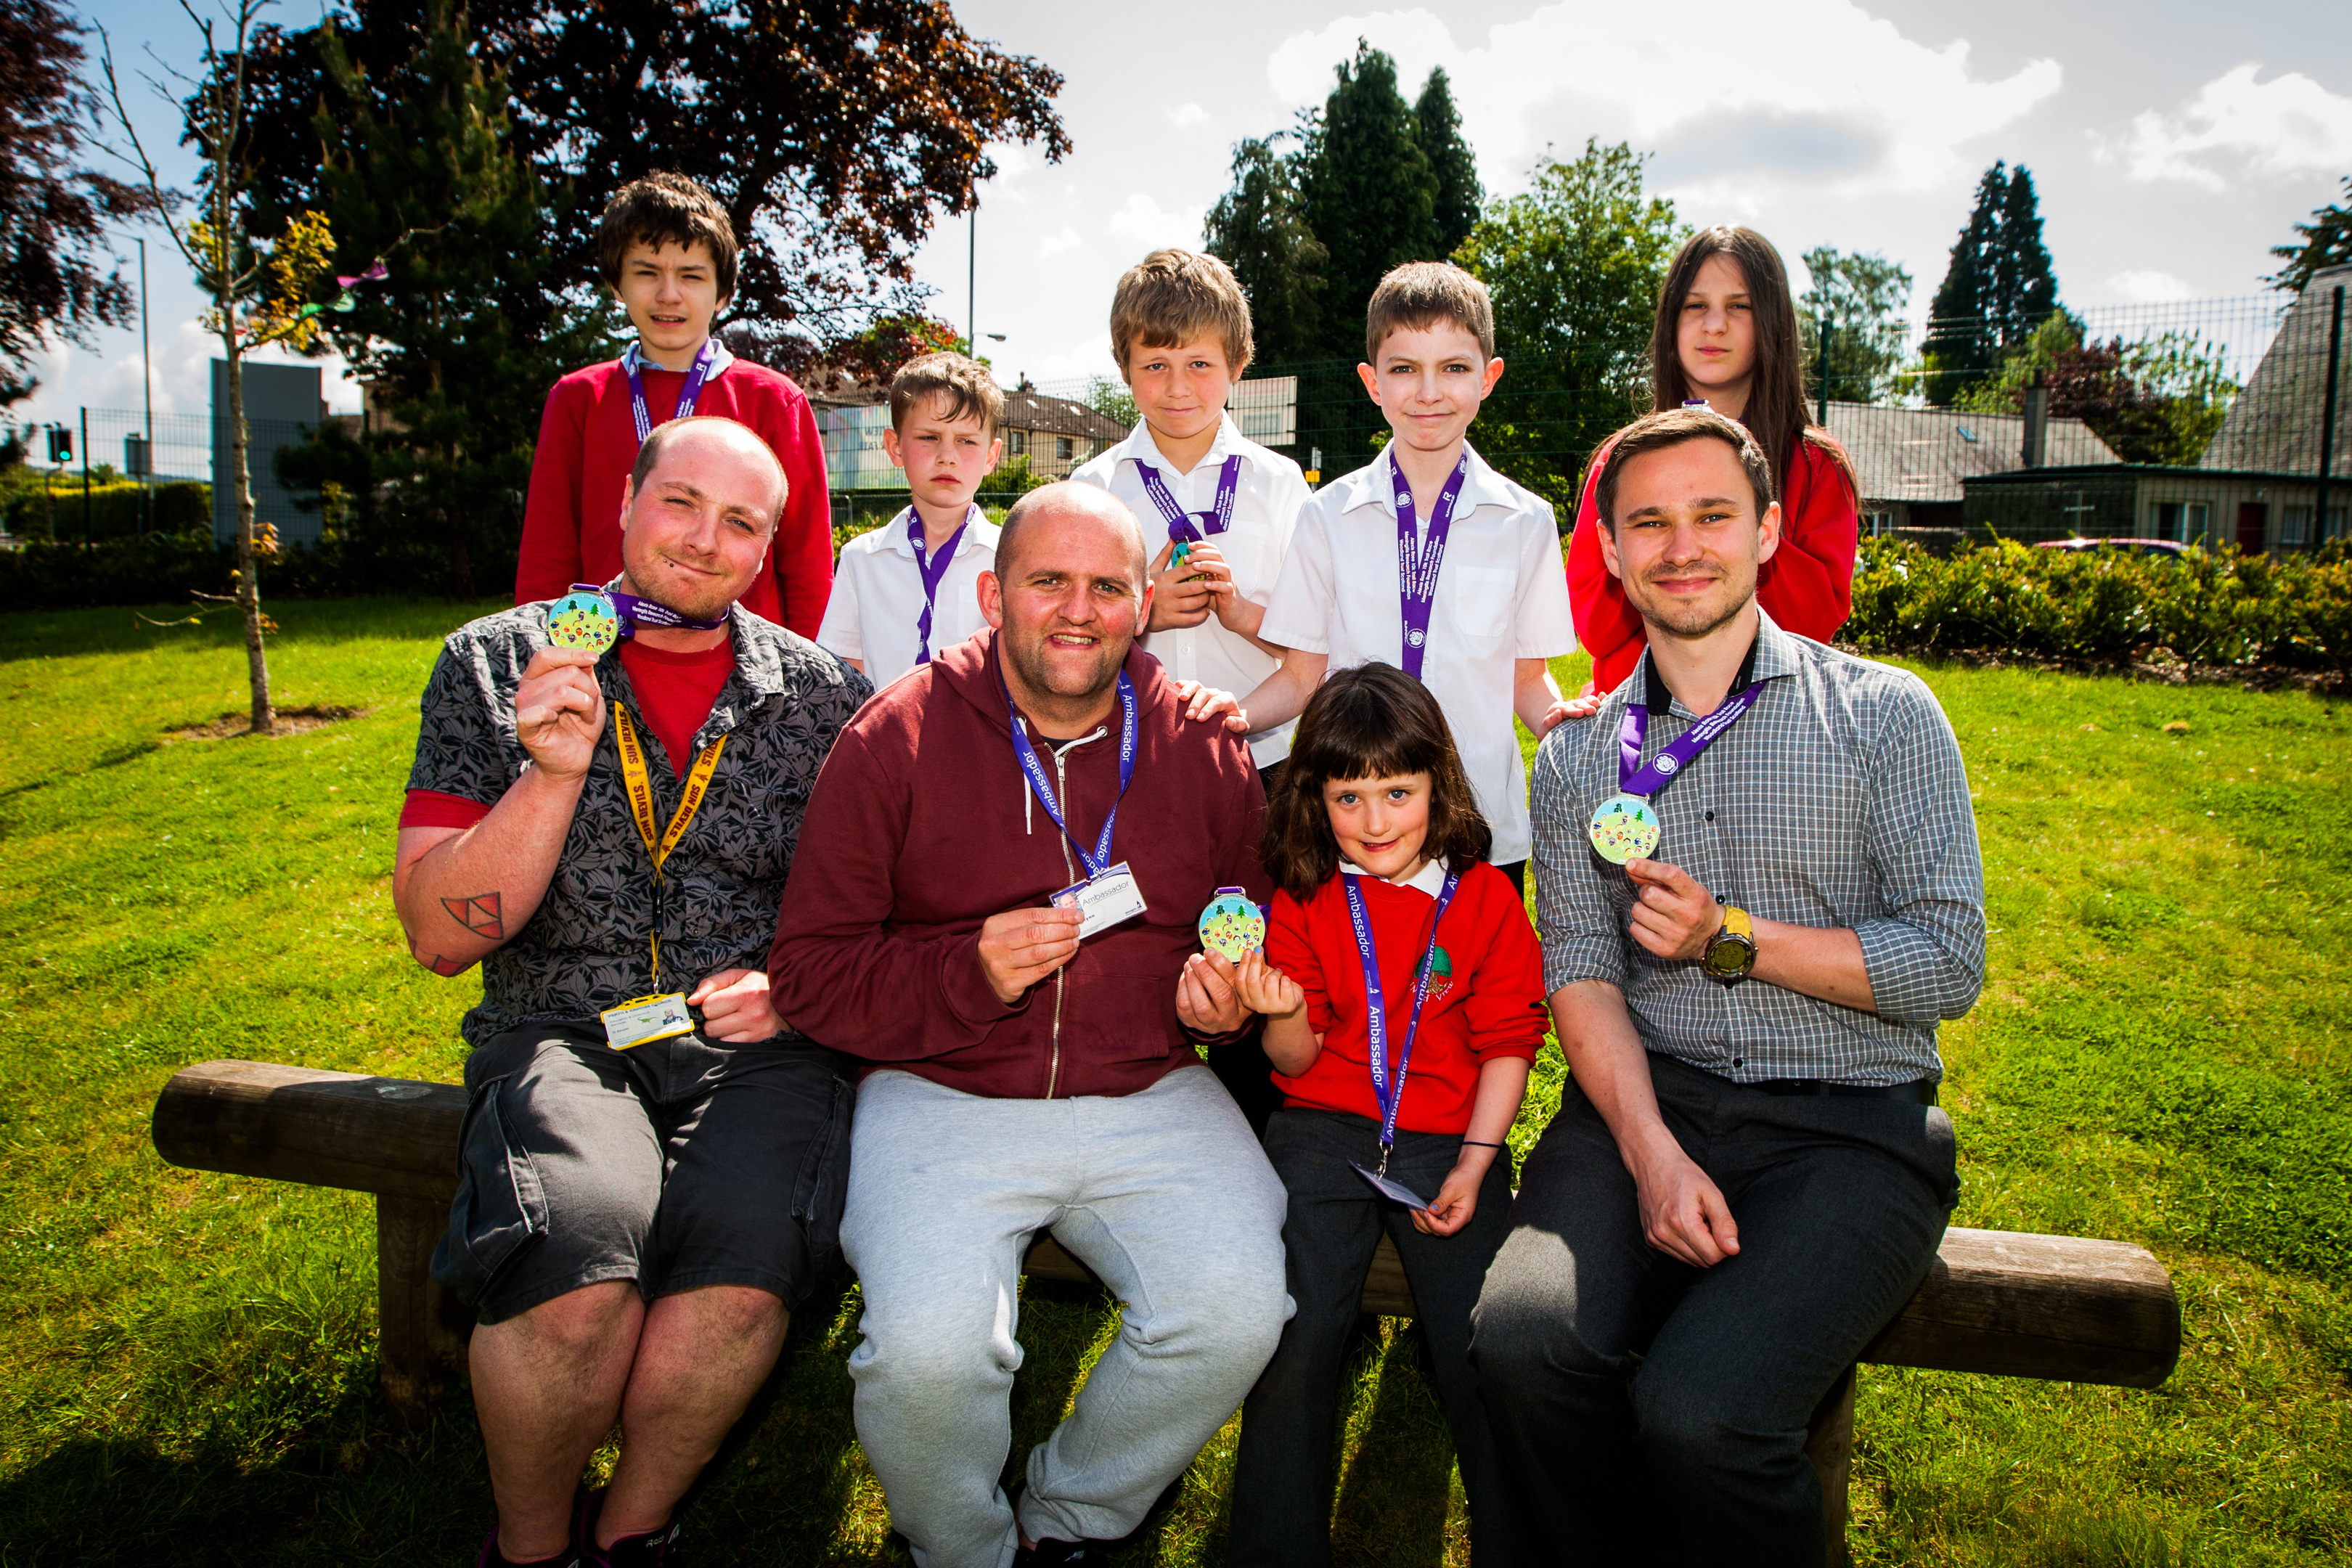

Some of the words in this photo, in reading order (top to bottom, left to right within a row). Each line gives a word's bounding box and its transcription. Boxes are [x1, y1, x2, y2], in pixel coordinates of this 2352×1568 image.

[625, 744, 639, 764] SUN
[1122, 695, 1135, 762] Ambassador
[689, 784, 701, 806] SUN
[1023, 751, 1060, 817] Ambassador
[640, 820, 654, 841] SUN
[1082, 881, 1130, 907] Ambassador
[1347, 885, 1371, 959] Ambassador
[1416, 934, 1437, 1010] Ambassador
[1369, 1005, 1385, 1089] Ambassador
[1387, 1056, 1409, 1138] Ambassador
